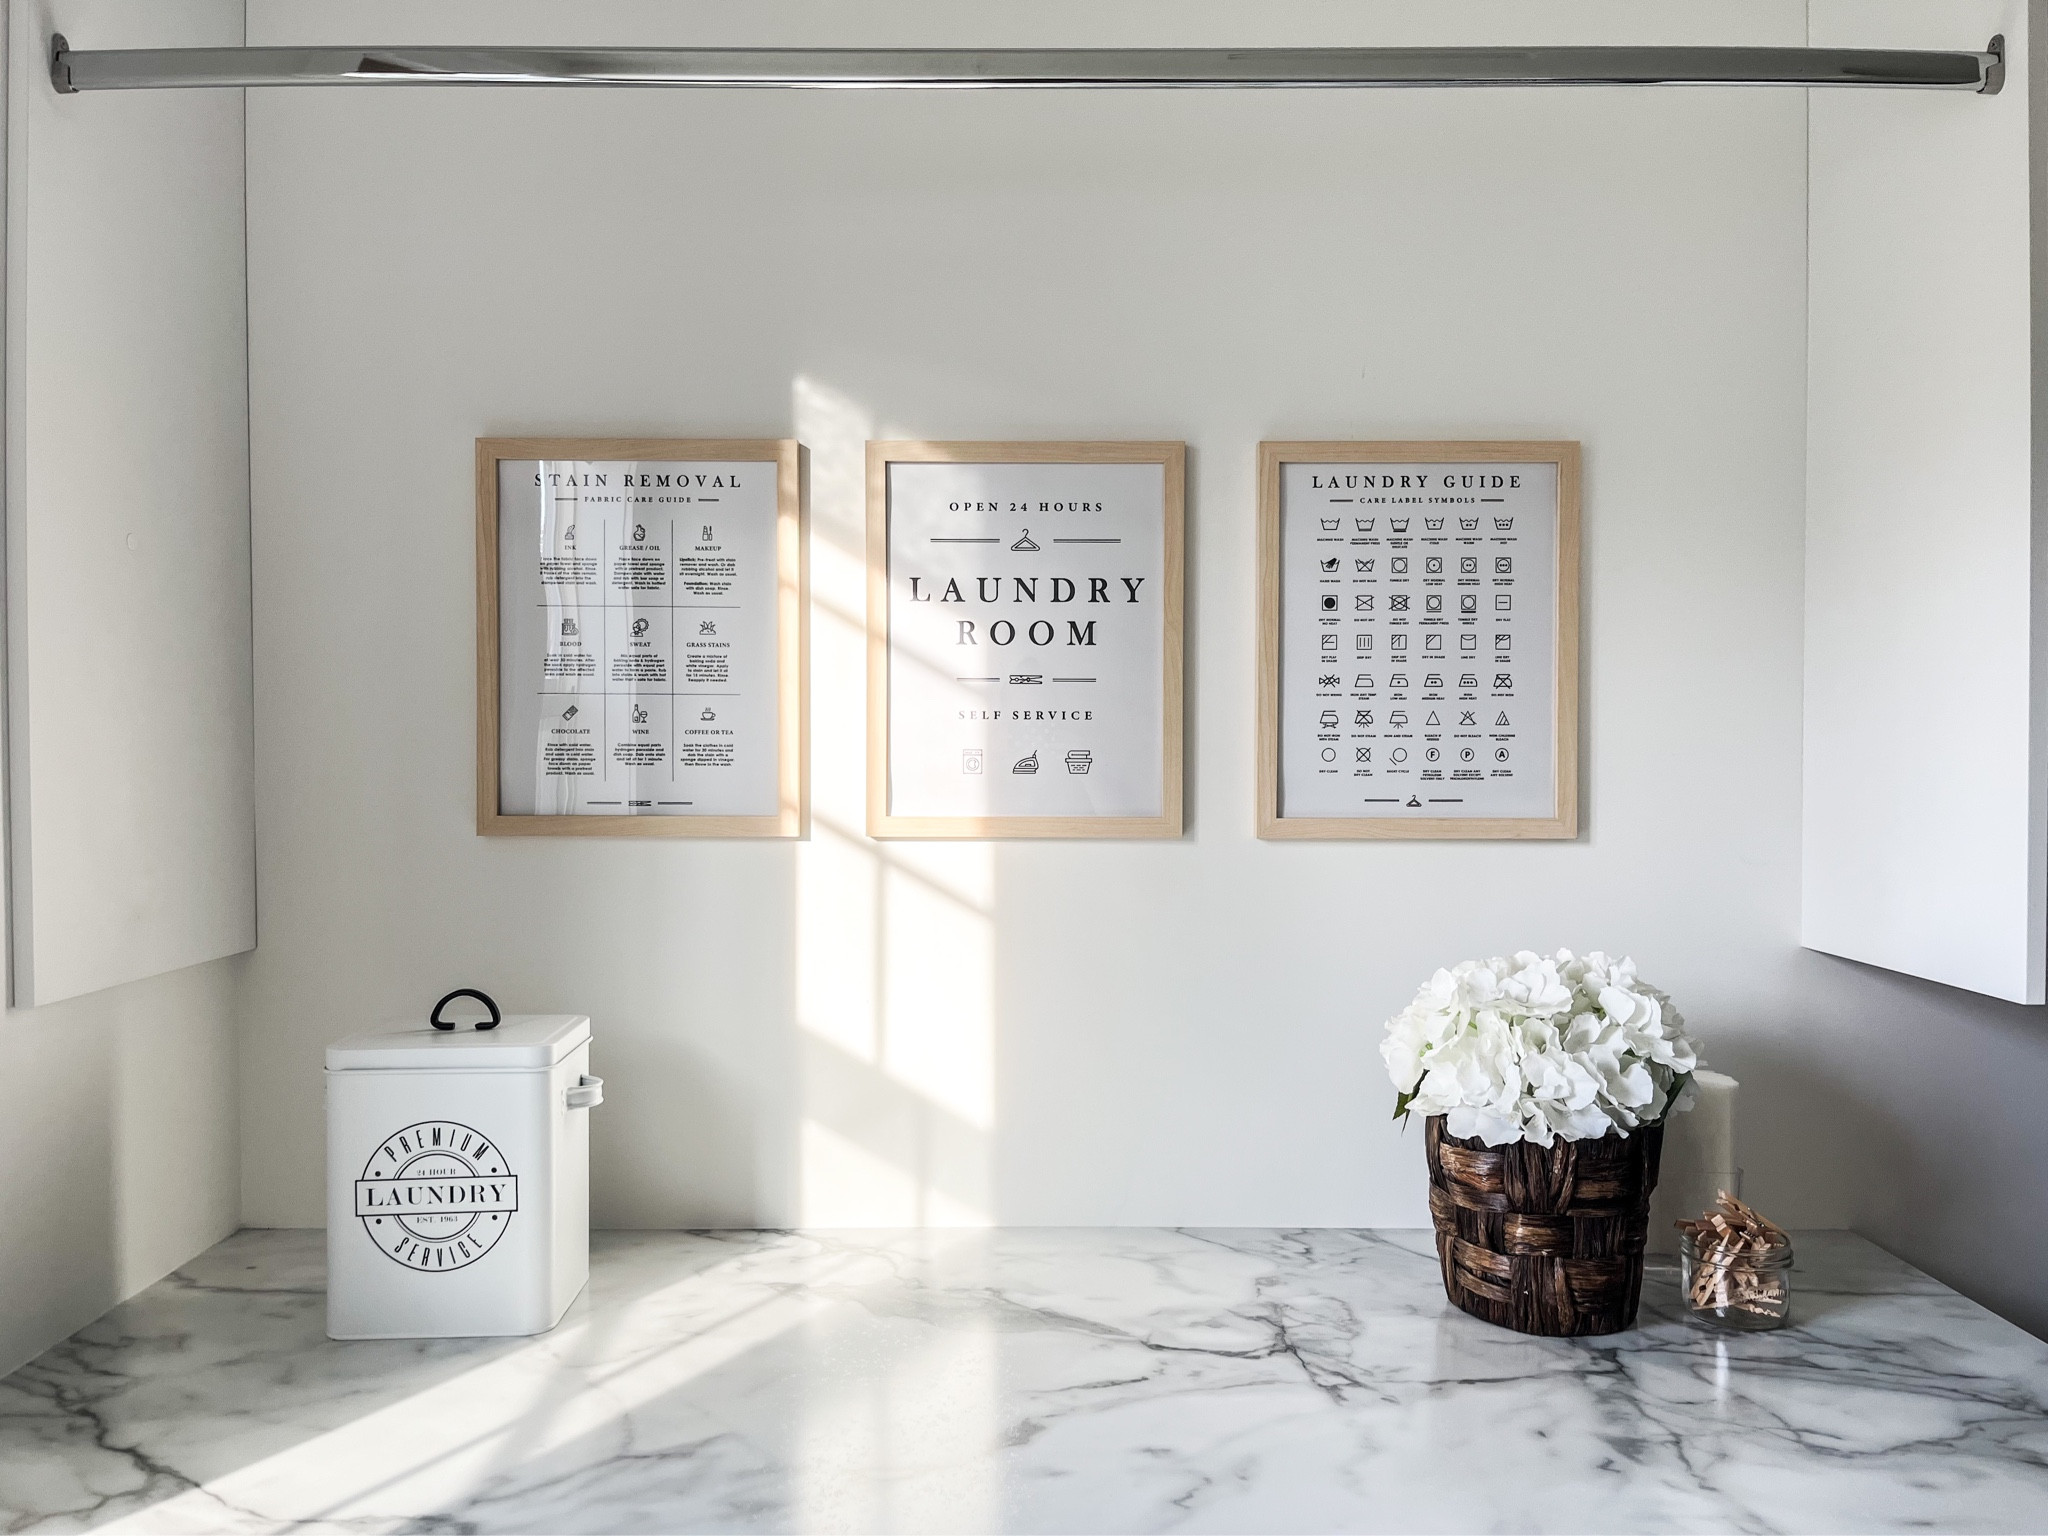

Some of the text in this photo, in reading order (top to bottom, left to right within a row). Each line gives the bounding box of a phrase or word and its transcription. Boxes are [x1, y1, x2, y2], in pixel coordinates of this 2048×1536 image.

[534, 474, 740, 488] STAIN REMOVAL
[1312, 476, 1521, 488] LAUNDRY GUIDE
[949, 502, 1103, 512] OPEN 24 HOURS
[909, 576, 1145, 603] LAUNDRY
[955, 620, 1097, 646] ROOM
[958, 710, 1094, 721] SELF SERVICE
[384, 1128, 489, 1162] PREMIUM
[366, 1184, 507, 1206] LAUNDRY
[394, 1234, 482, 1267] SERVICE
